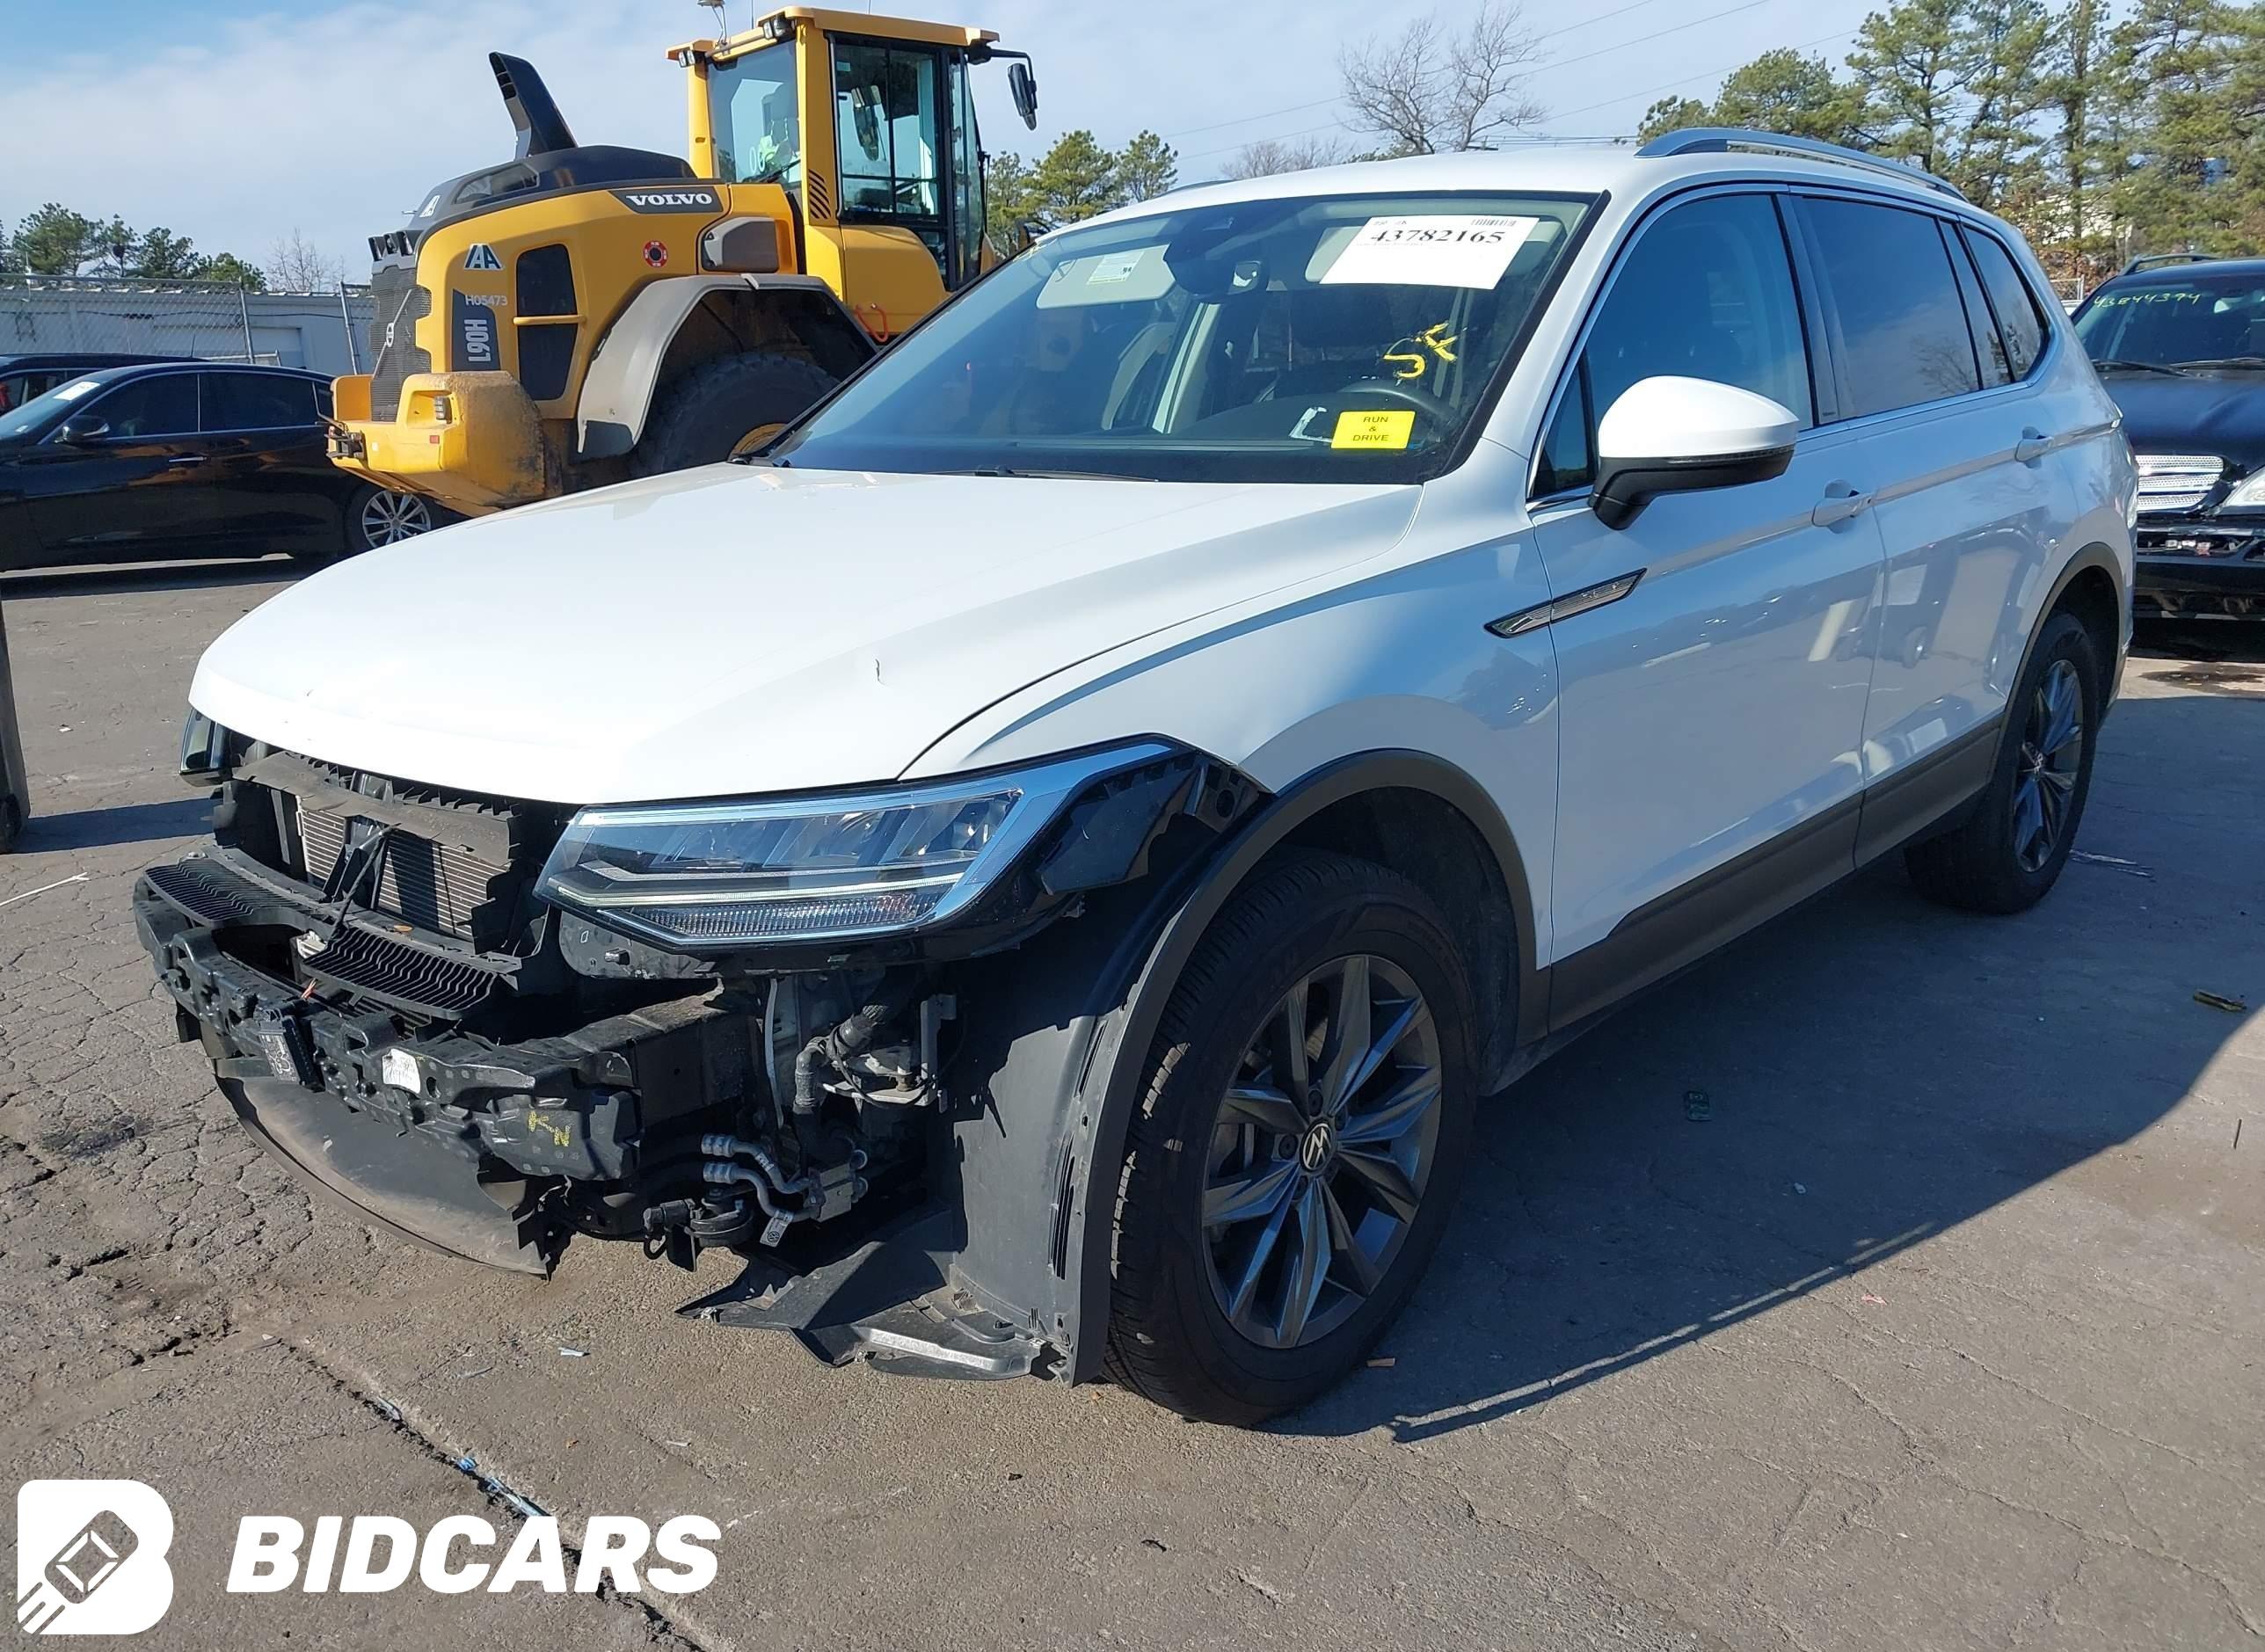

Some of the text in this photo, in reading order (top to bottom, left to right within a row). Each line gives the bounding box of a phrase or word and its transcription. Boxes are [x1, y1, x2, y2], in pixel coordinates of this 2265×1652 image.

[626, 193, 713, 206] VOLVO
[1371, 229, 1506, 244] 43782165
[465, 295, 508, 306] H05473
[463, 319, 492, 362] L90H
